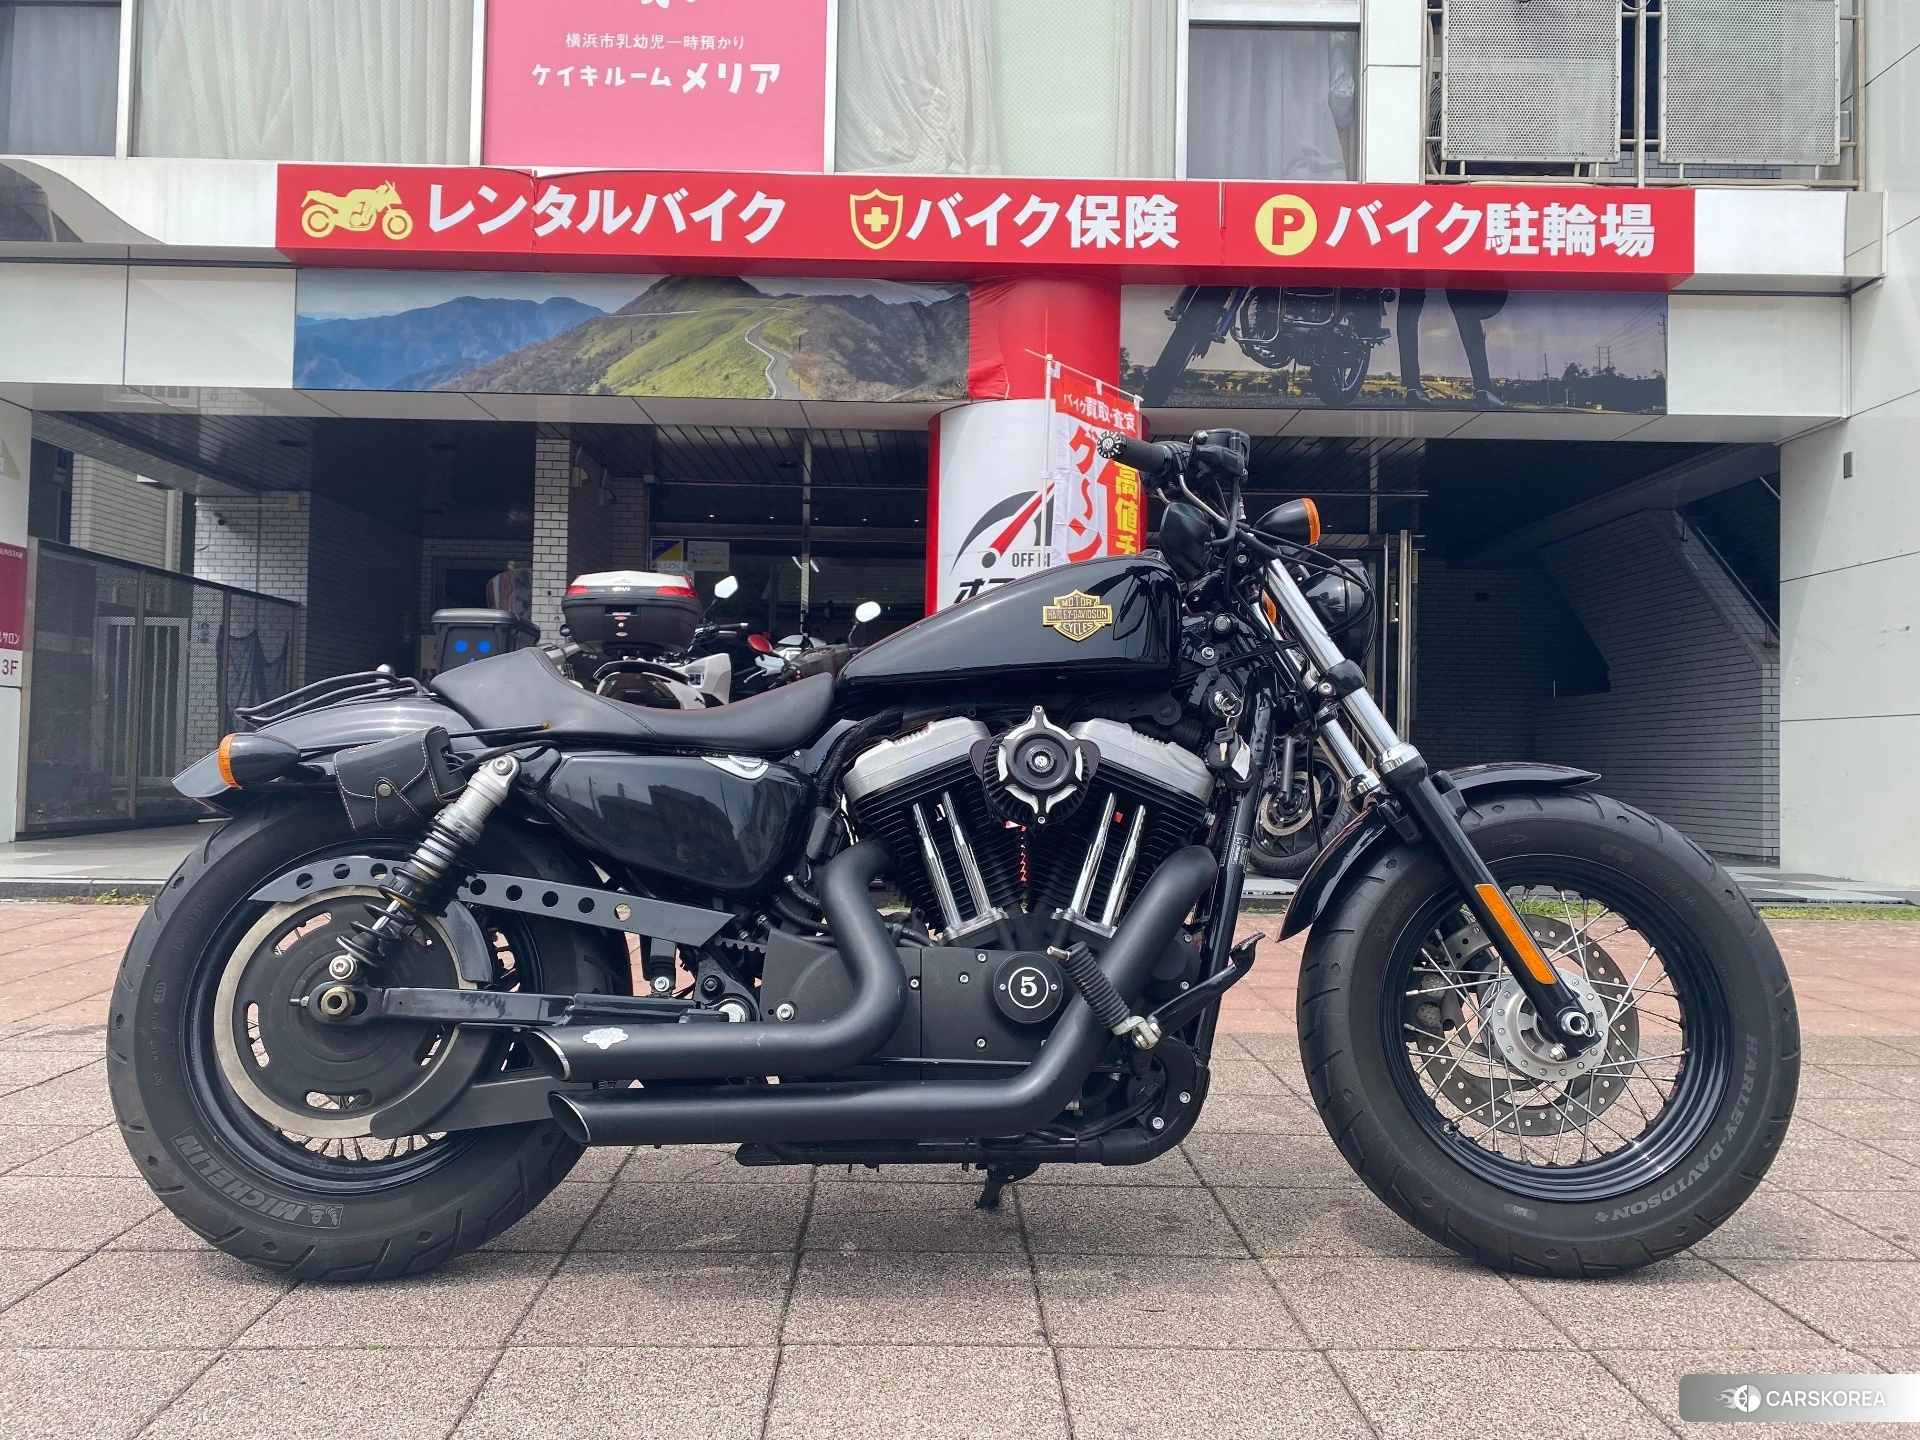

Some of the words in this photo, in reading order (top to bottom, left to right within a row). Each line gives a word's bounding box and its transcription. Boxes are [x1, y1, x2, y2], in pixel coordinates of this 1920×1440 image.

[566, 32, 745, 50] 横浜市乳幼児一時預かり
[532, 64, 672, 87] ケイキルーム
[682, 62, 780, 94] メリア
[429, 183, 786, 244] レンタルバイク
[906, 191, 1180, 249] バイク保険
[1272, 207, 1306, 246] P
[1325, 199, 1656, 257] バイク駐輪場
[1012, 552, 1034, 568] OFF
[1061, 595, 1093, 607] MOTOR
[1047, 608, 1108, 620] HARLEY-DAVIDSON
[1062, 622, 1094, 636] CYCLES
[2, 659, 19, 675] 3F
[1020, 975, 1038, 997] 5
[1611, 1033, 1759, 1221] HARLEY-DAVIDSON
[176, 1135, 303, 1222] MICHELIN
